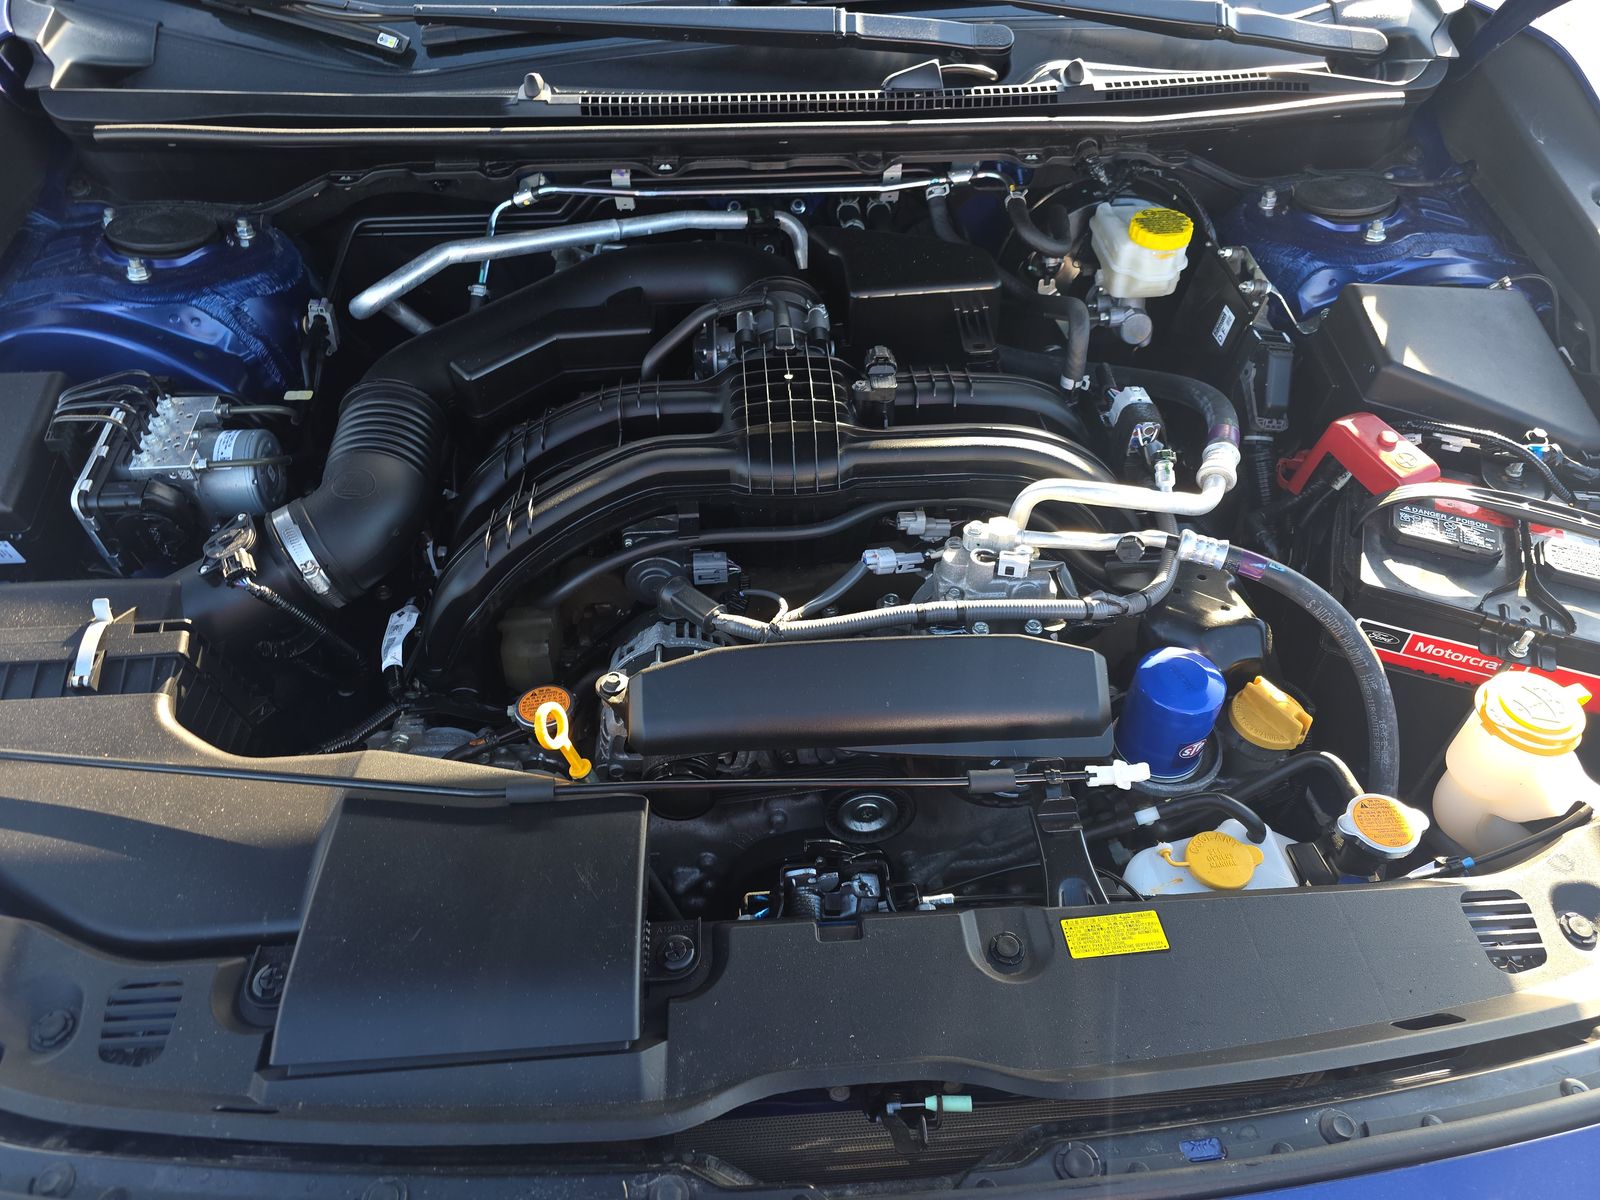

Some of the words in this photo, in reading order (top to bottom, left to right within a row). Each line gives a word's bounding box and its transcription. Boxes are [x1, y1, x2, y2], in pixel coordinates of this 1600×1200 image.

[1412, 507, 1447, 520] DANGER
[1456, 517, 1488, 529] POISON
[1367, 631, 1394, 643] Ford
[1414, 641, 1501, 670] Motorcra
